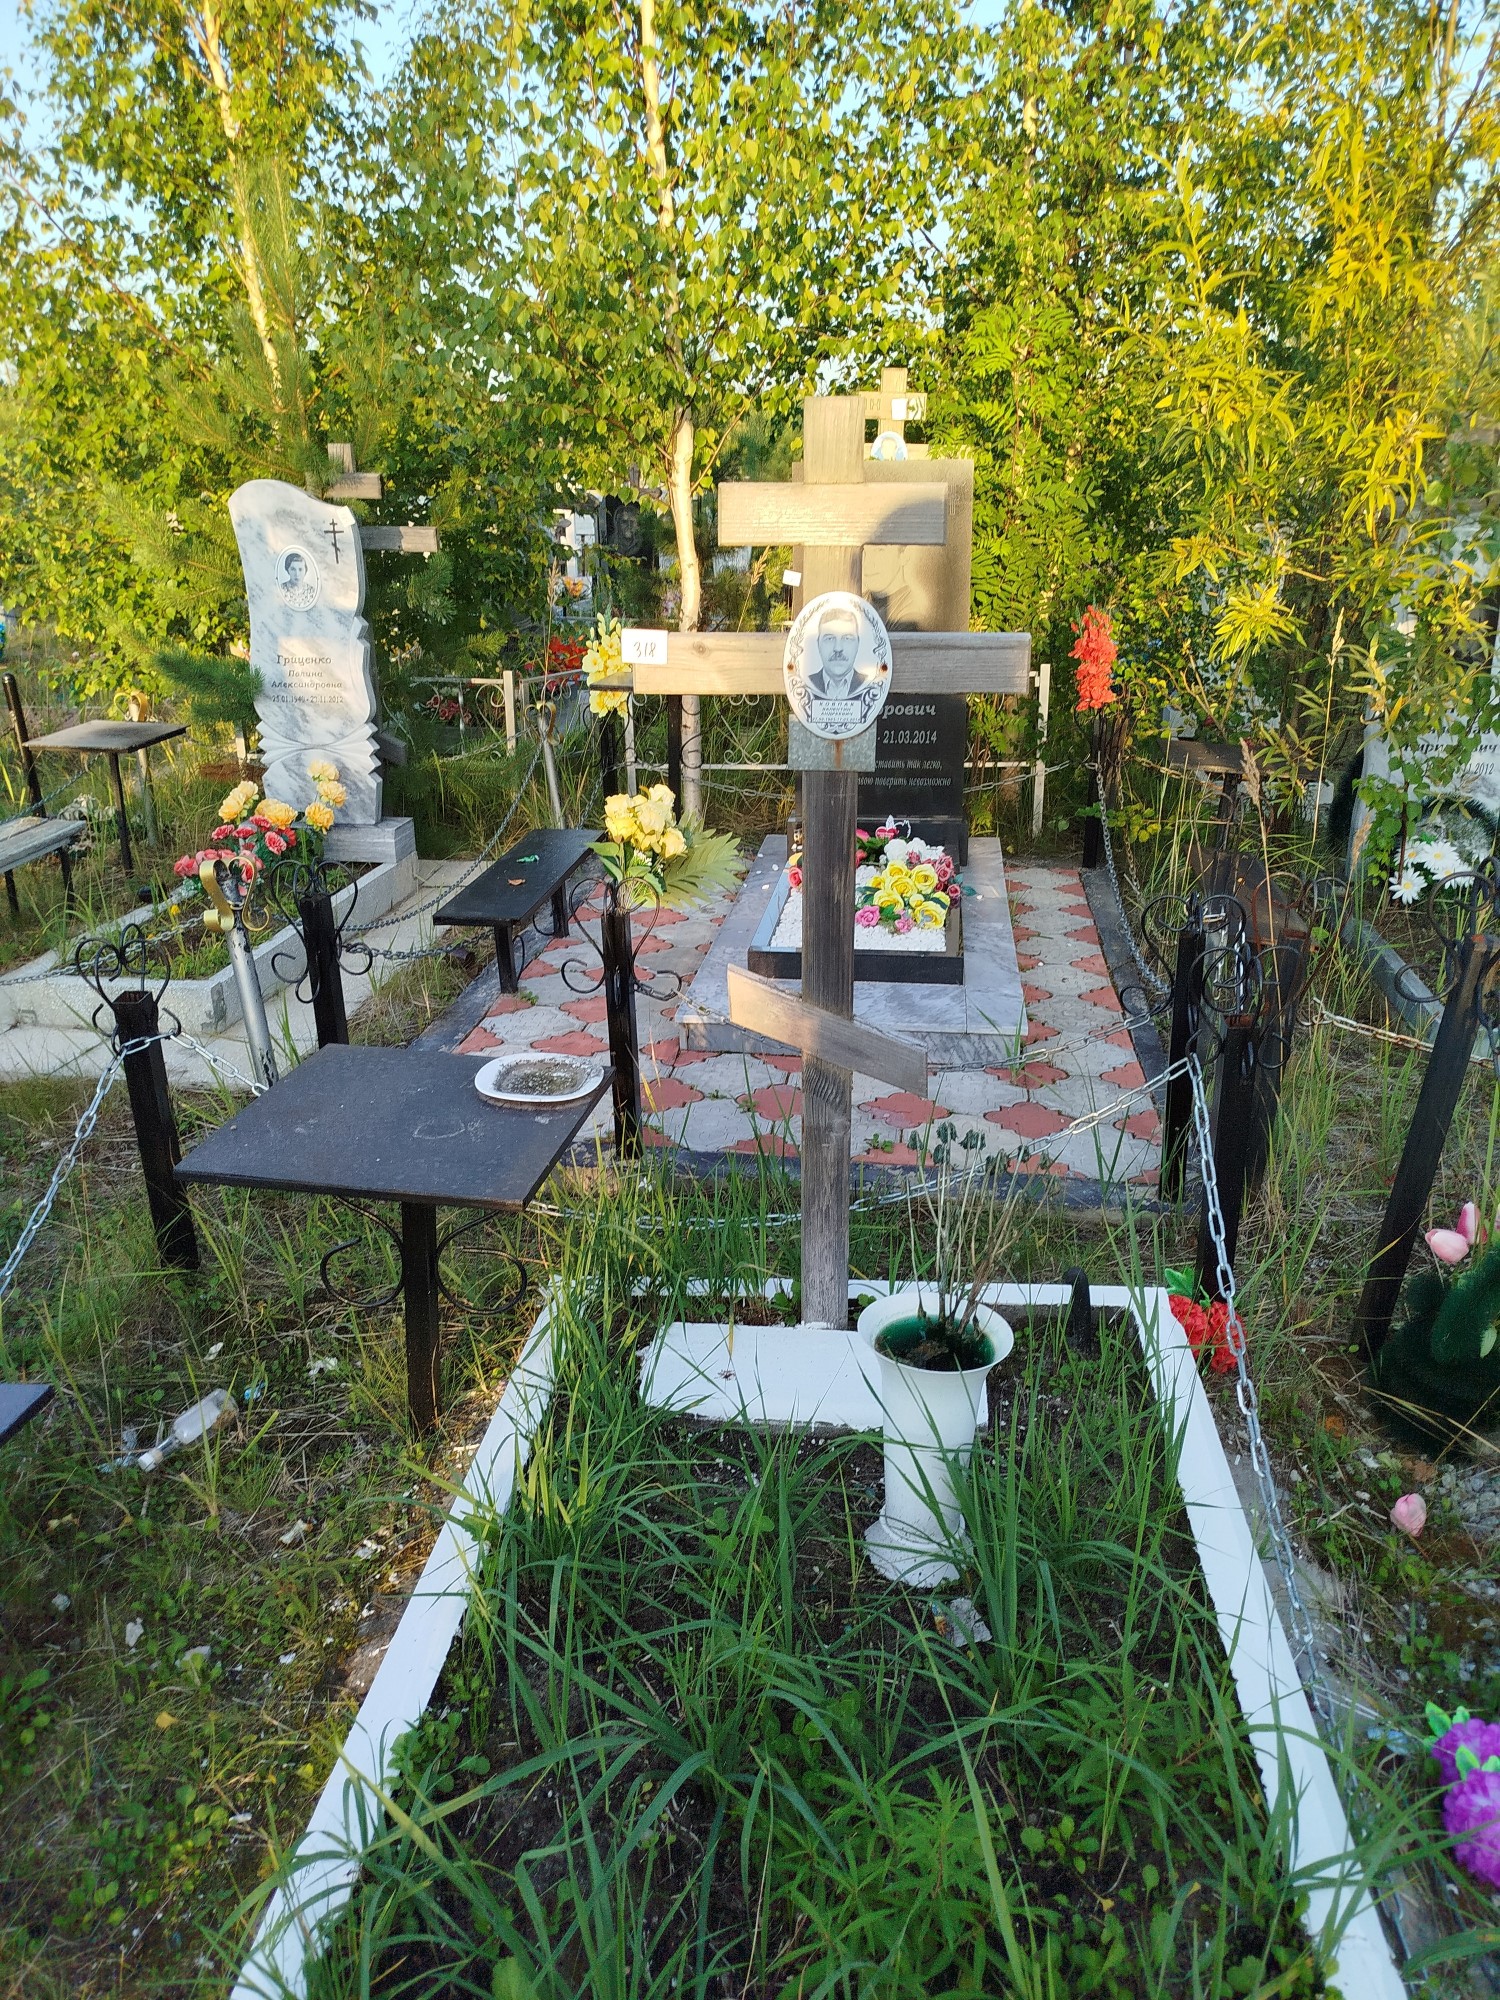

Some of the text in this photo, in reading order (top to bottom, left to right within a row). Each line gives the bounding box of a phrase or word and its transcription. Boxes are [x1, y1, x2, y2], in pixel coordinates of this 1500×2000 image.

[633, 641, 657, 658] 318
[276, 654, 332, 666] Гриценко
[288, 669, 323, 678] Полина
[271, 680, 343, 690] Александровна
[882, 730, 938, 744] 21.03.2014
[875, 760, 906, 769] ставить
[906, 760, 921, 769] так
